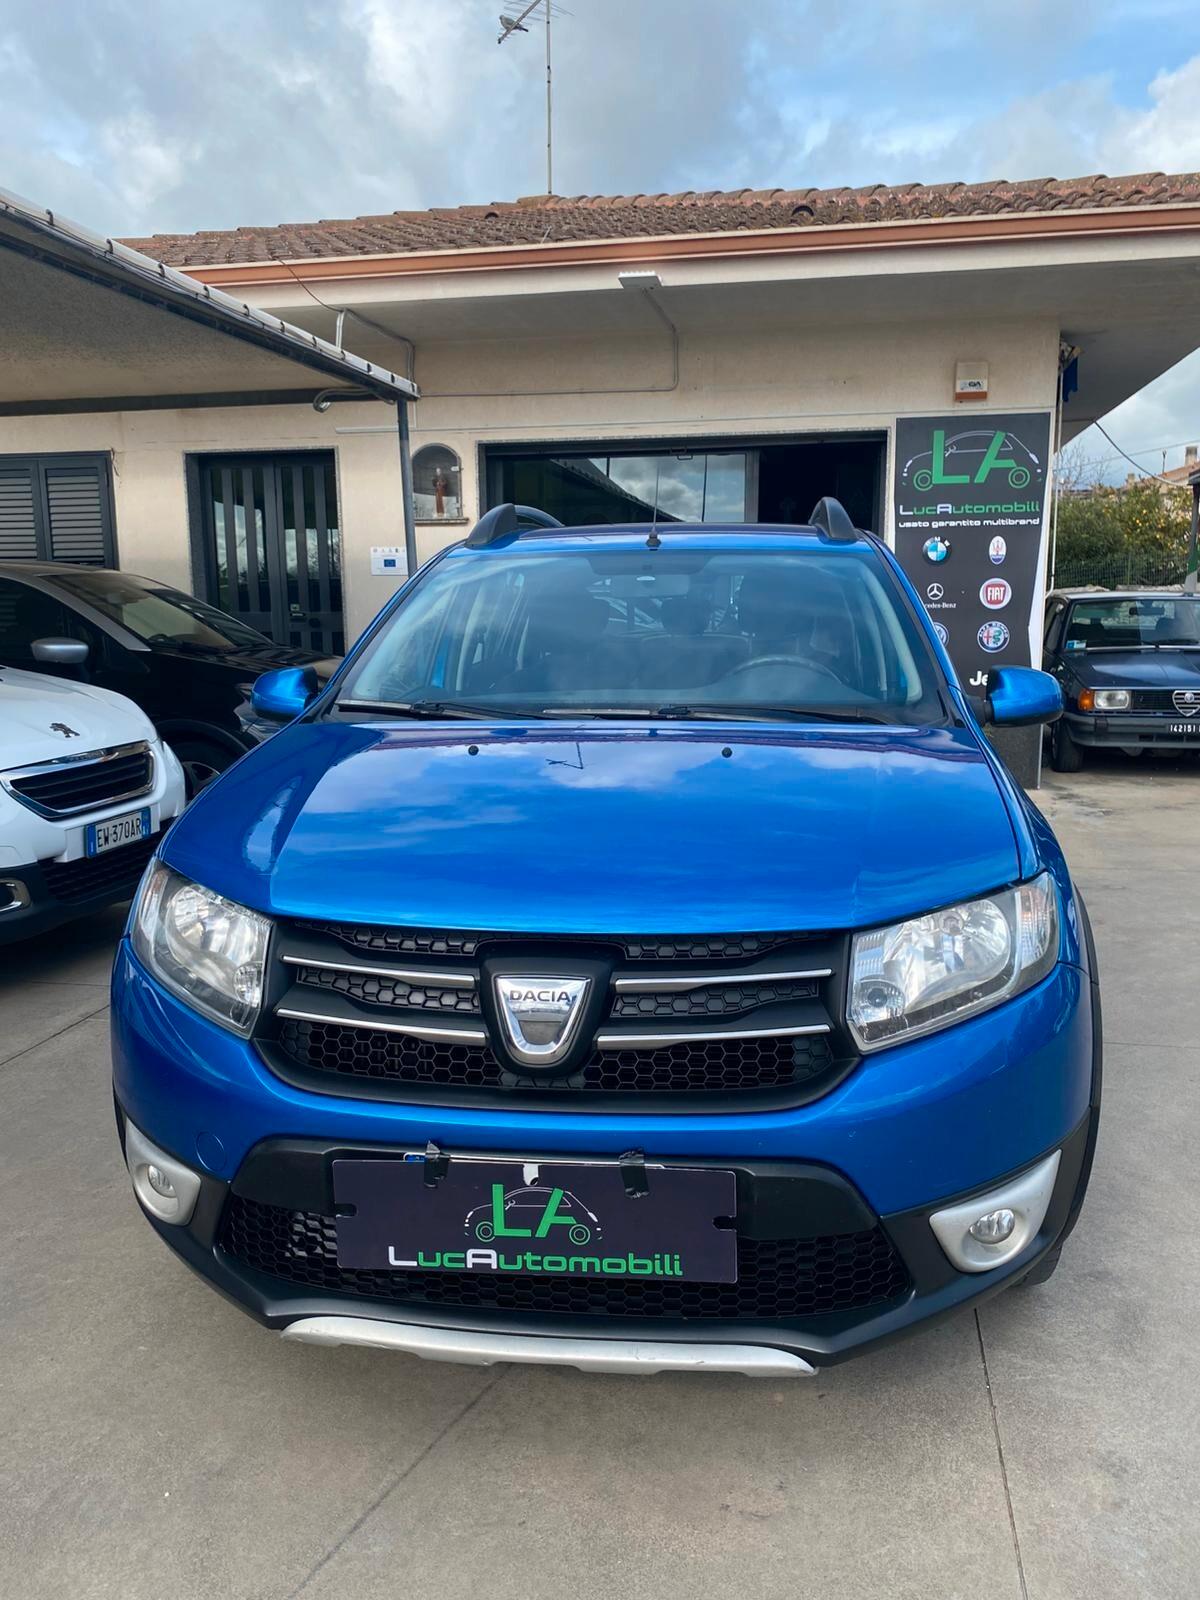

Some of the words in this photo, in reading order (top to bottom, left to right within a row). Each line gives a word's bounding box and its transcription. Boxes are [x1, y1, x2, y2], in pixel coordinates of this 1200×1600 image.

[899, 501, 1040, 515] LucAutomobili
[898, 520, 930, 528] usato
[932, 518, 981, 529] garantito
[983, 517, 1040, 526] multibrand
[987, 587, 1006, 601] FIAT
[969, 670, 989, 686] Je
[509, 990, 571, 1002] DACIA
[388, 1245, 684, 1277] LucAutomobili
